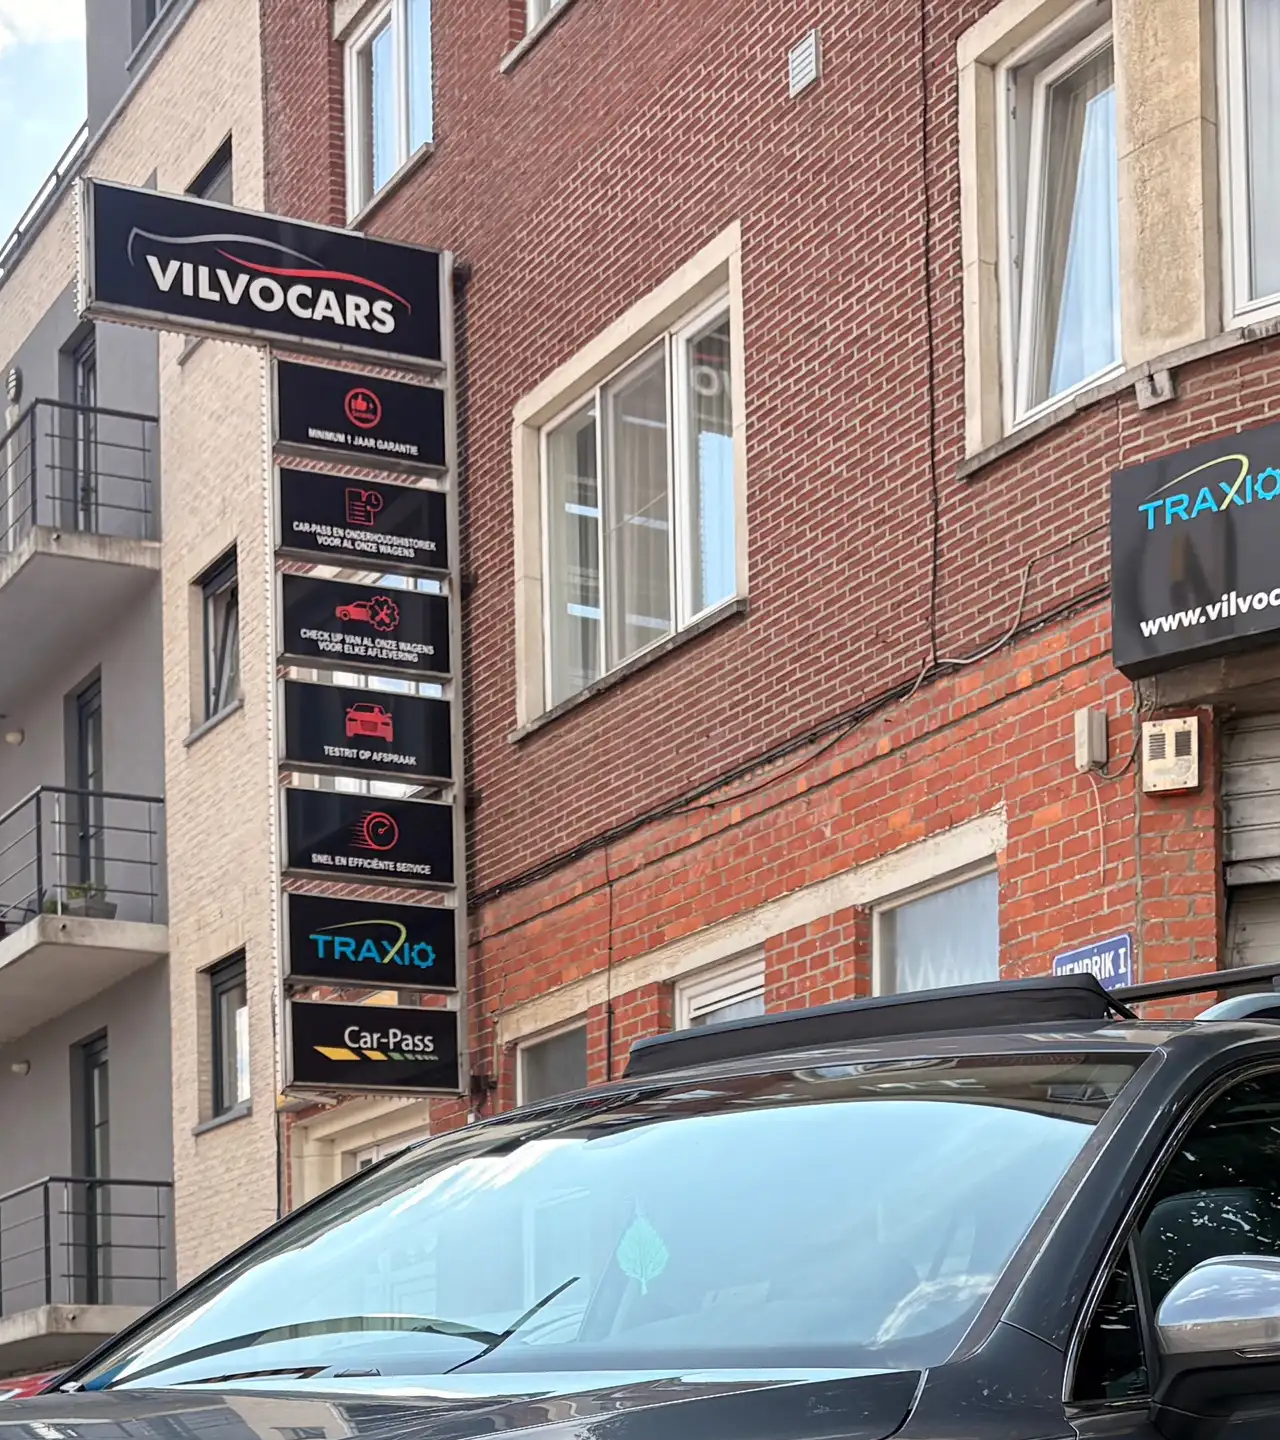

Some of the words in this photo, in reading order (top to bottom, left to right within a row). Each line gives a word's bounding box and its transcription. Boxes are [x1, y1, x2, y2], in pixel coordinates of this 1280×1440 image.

[145, 255, 396, 334] VILVOCARS
[308, 427, 346, 444] MINIMUM
[353, 437, 376, 449] JAAR
[376, 440, 419, 456] GARANTIE
[293, 521, 332, 536] CAR-PASS
[332, 528, 345, 538] EN
[316, 535, 342, 548] VOOR
[343, 540, 354, 549] AL
[355, 541, 378, 553] ONZE
[379, 544, 415, 558] WAGENS
[300, 628, 330, 641] CHECK
[331, 632, 344, 642] UP
[344, 634, 362, 645] VAN
[363, 637, 373, 647] AL
[374, 638, 398, 650] ONZE
[398, 641, 435, 656] WAGENS
[317, 641, 343, 653] VOOR
[344, 644, 366, 656] ELKE
[367, 646, 419, 662] AFLEVERING
[323, 745, 358, 759] TESTRIT
[359, 750, 372, 760] OP
[372, 752, 417, 766] AFSPRAAK
[311, 853, 334, 866] SNEL
[335, 856, 347, 866] EN
[396, 862, 431, 875] SERVICE
[309, 933, 436, 969] TRAXIO
[344, 1026, 434, 1053] Car-Pass
